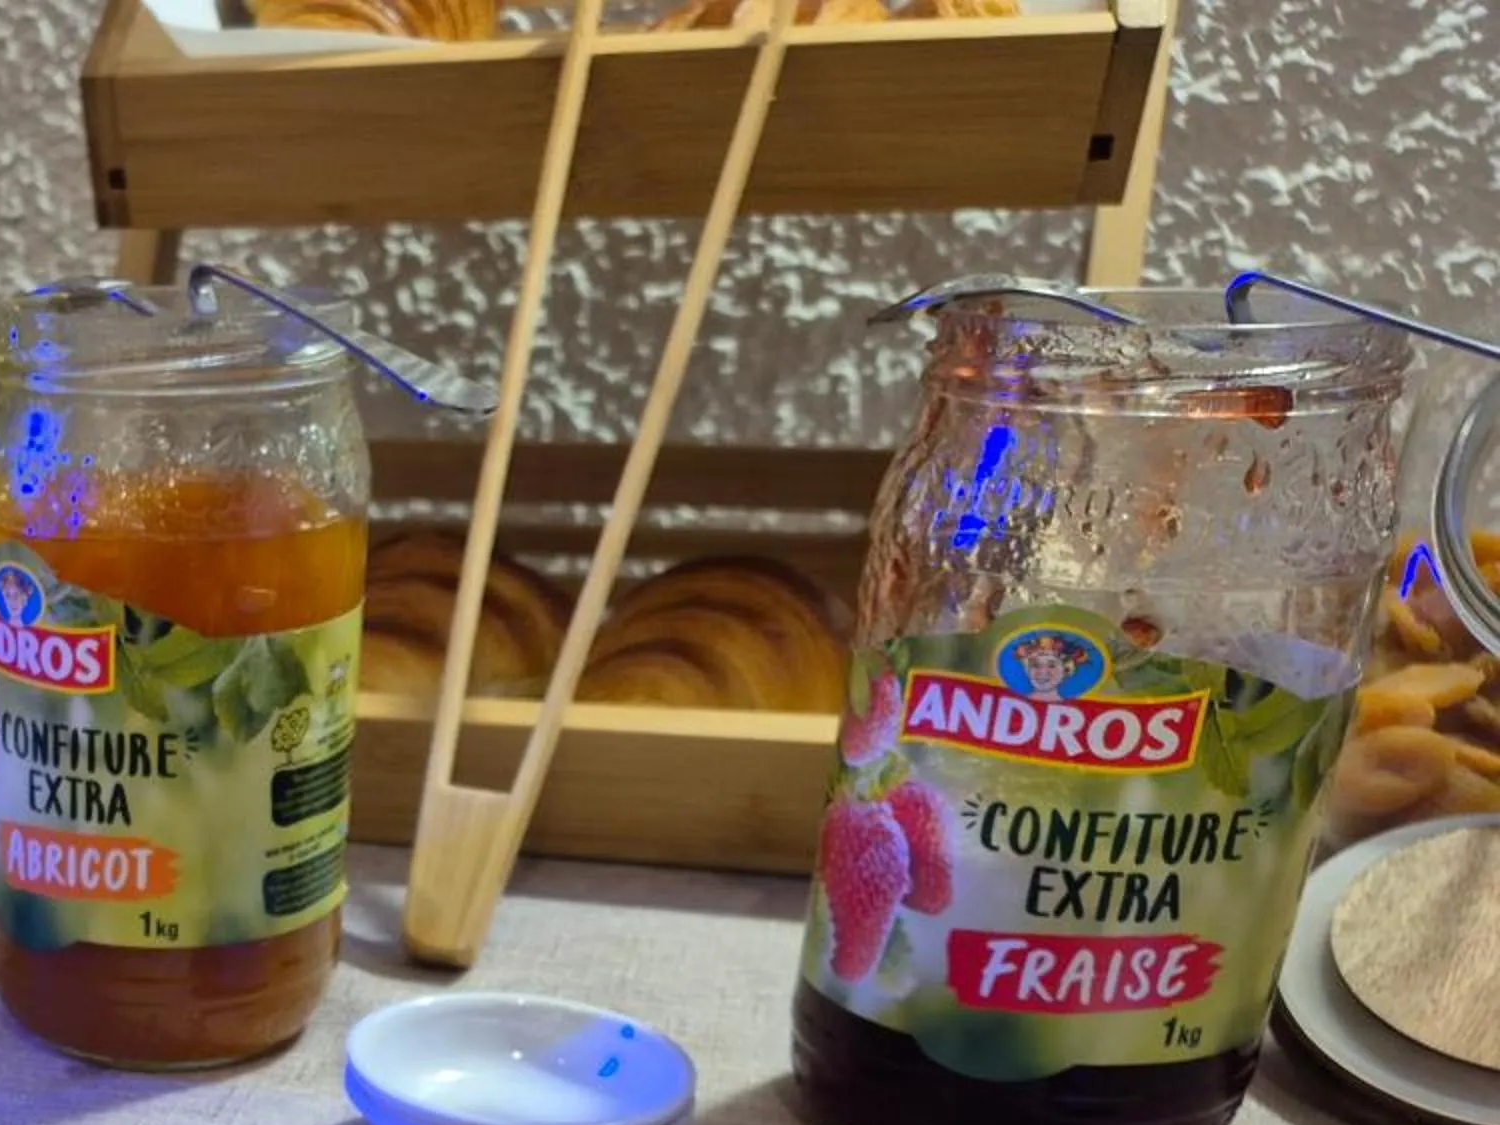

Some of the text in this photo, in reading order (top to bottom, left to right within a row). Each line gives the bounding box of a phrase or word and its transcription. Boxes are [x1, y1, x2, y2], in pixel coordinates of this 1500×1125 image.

[0, 712, 180, 779] CONFITURE
[907, 683, 1186, 762] ANDROS
[27, 769, 132, 827] EXTRA
[6, 829, 153, 892] ABRICOT
[979, 800, 1254, 866] CONFITURE
[1024, 866, 1181, 924] EXTRA
[978, 939, 1199, 1005] FRAISE
